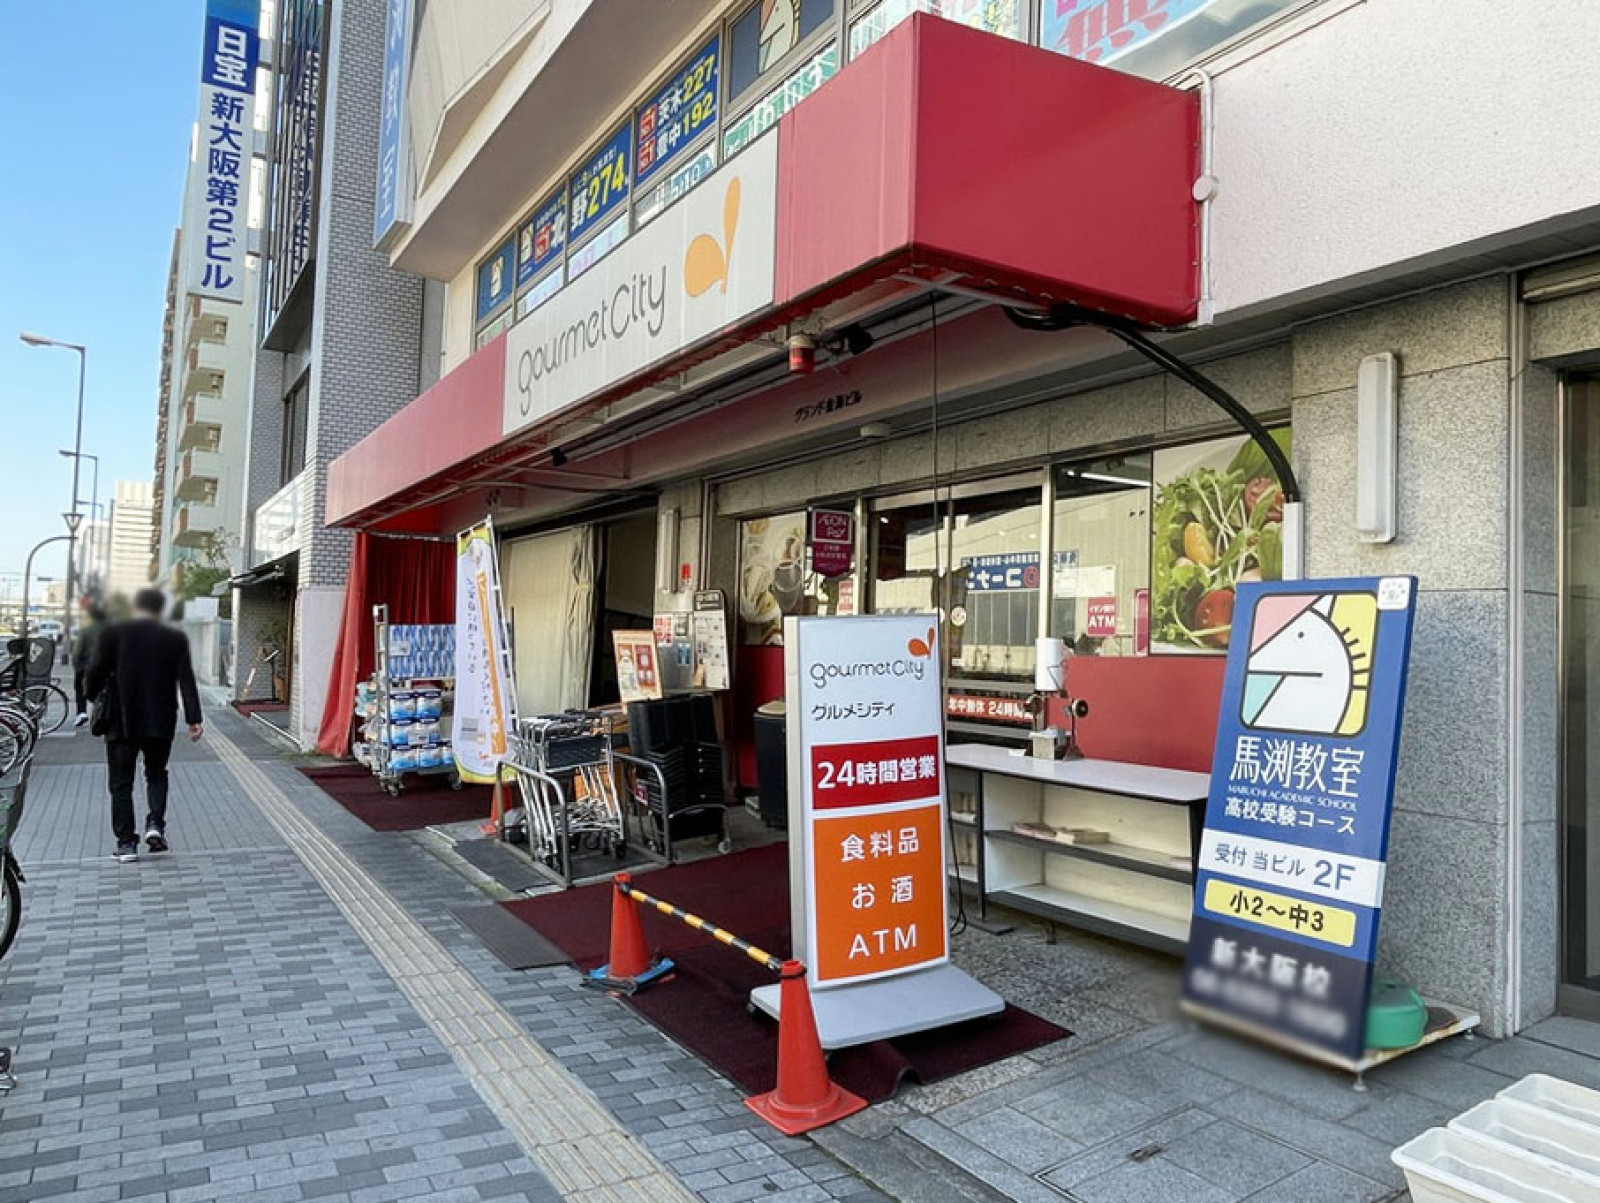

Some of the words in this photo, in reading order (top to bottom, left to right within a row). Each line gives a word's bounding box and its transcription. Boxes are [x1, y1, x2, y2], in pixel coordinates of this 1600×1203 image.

[213, 25, 248, 87] 日宝
[201, 92, 245, 289] 新大阪第2ビル
[1088, 614, 1116, 628] ATM
[811, 701, 895, 721] グルメシティ
[817, 755, 936, 789] 24時間営業
[1224, 796, 1356, 835] 高校受験コース
[1317, 796, 1357, 812] SCHOOL
[840, 826, 919, 863] 食料品
[1215, 842, 1248, 868] 受付
[1251, 850, 1306, 878] 当ビル
[1312, 858, 1357, 891] 2F
[848, 923, 918, 960] ATM
